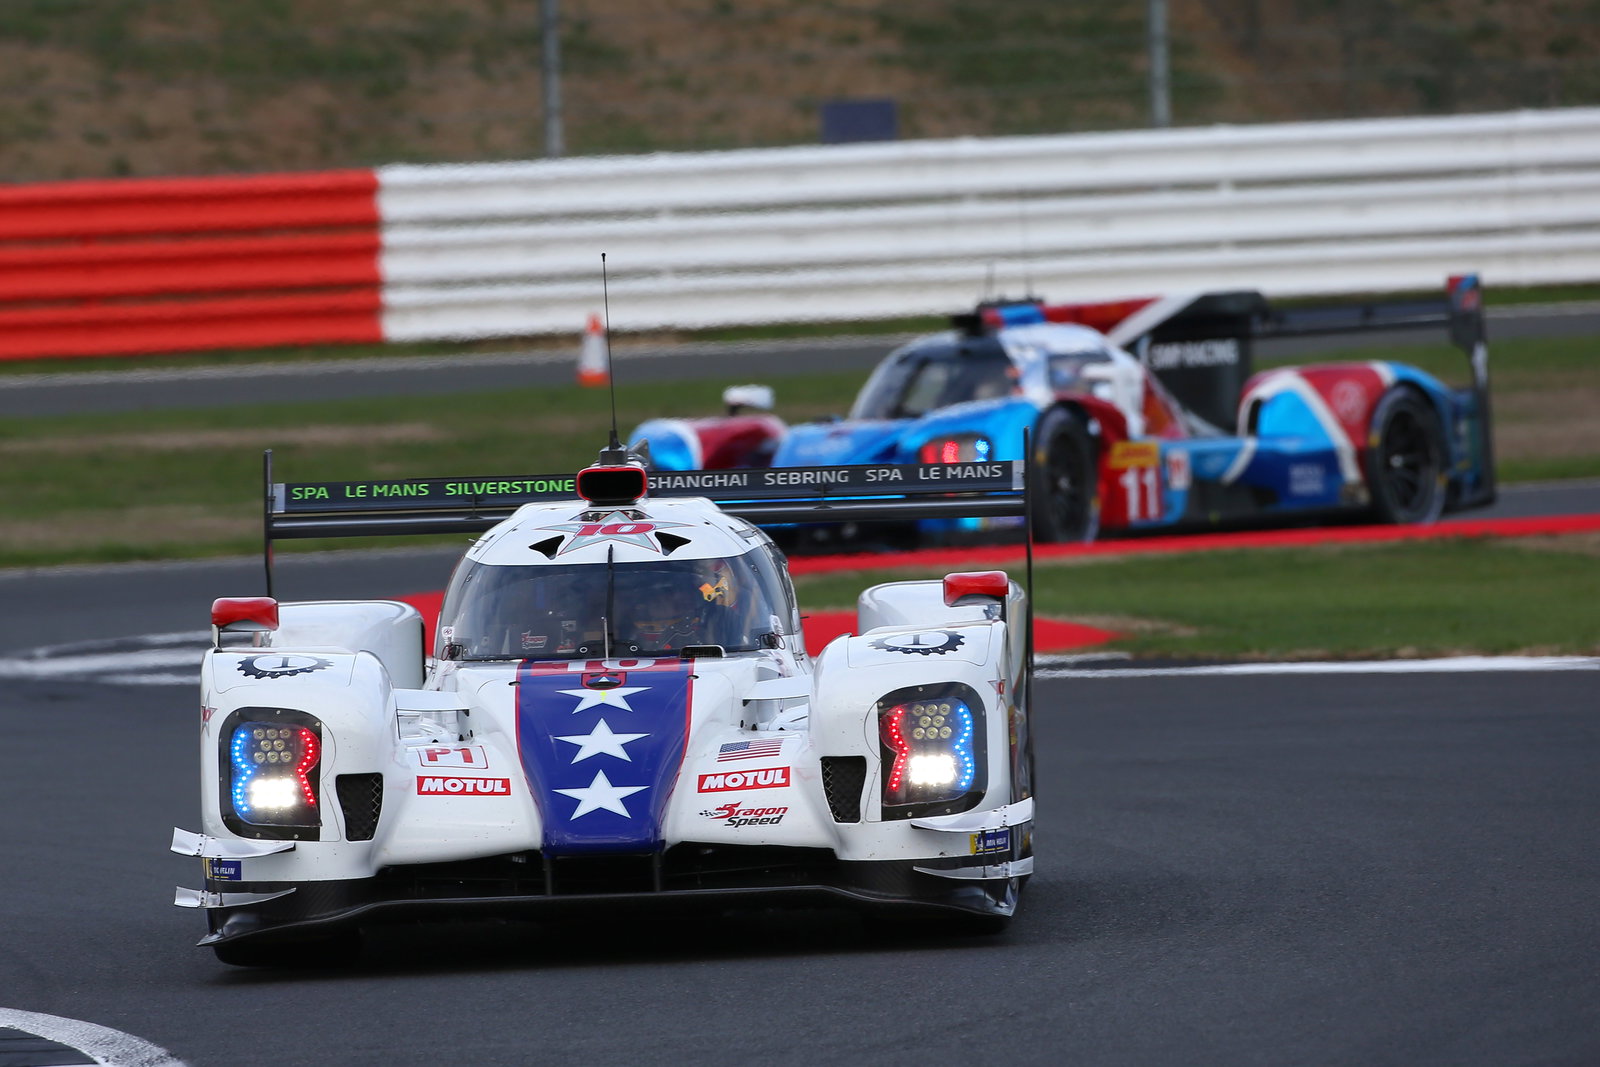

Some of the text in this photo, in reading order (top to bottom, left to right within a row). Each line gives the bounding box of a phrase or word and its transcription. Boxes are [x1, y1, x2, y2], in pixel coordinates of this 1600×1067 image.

[647, 465, 1002, 489] SHANGHAI SEBRING SPA LE MANS
[292, 480, 575, 500] SPA LE MANS SILVERSTONE
[1119, 467, 1159, 520] 11
[574, 523, 655, 537] 10
[425, 748, 473, 763] P1
[421, 778, 507, 793] MOTUL
[701, 769, 787, 790] MOTUL
[724, 815, 784, 828] Speed
